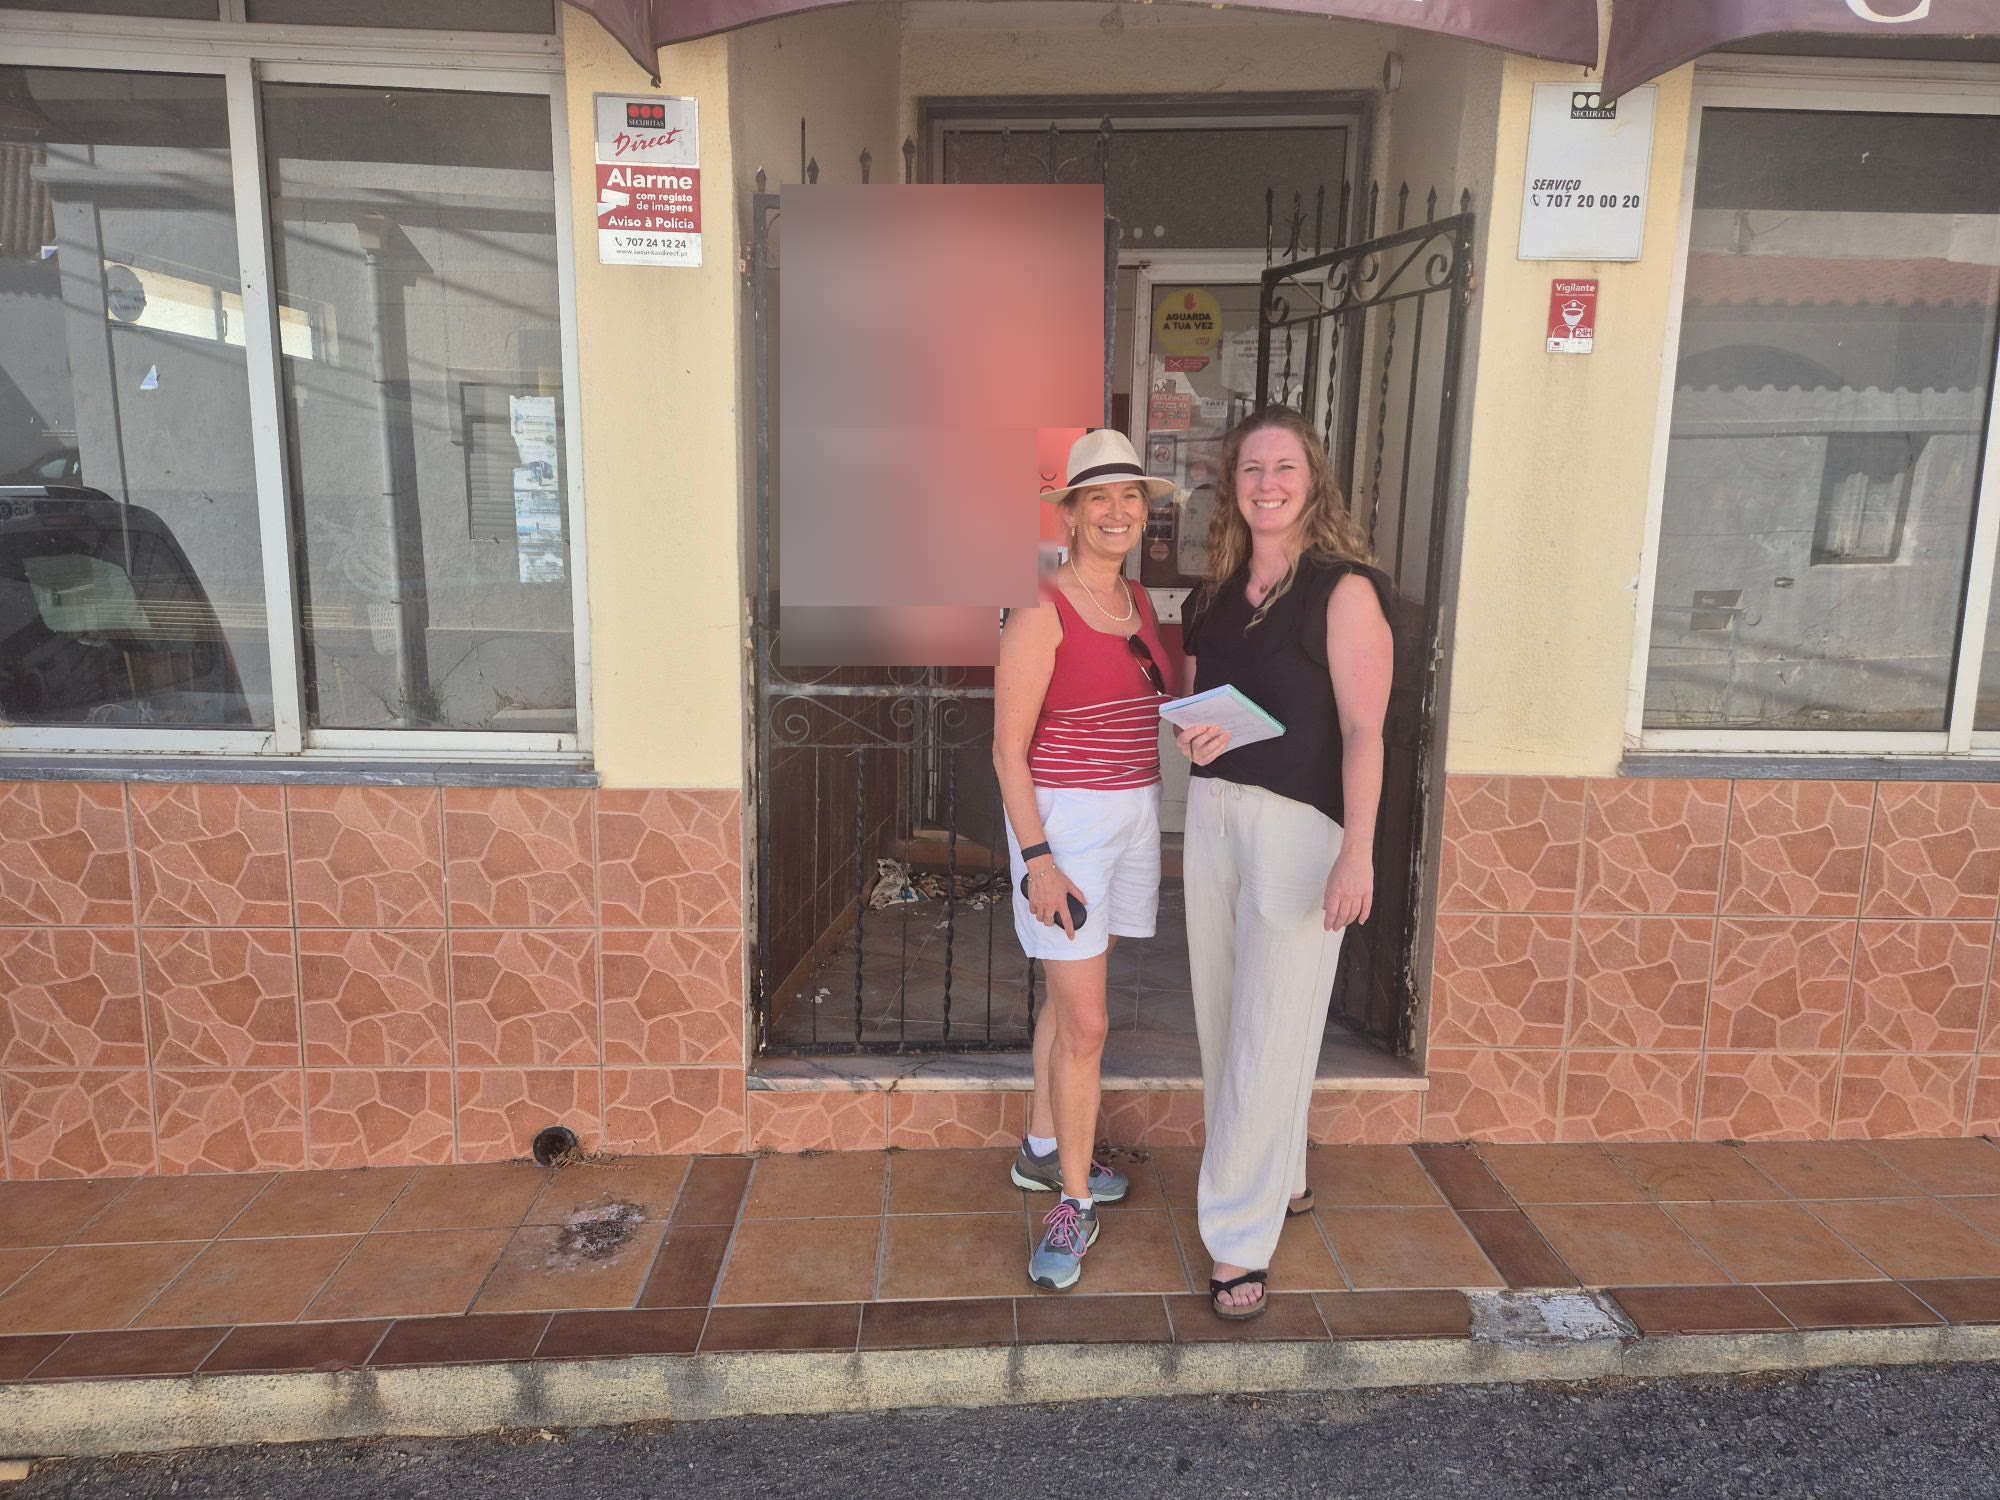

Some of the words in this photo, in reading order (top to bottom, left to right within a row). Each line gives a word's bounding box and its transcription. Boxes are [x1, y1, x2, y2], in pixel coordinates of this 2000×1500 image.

[628, 119, 665, 127] SECURITAS
[613, 127, 684, 157] Direct
[606, 167, 693, 190] Alarme
[1532, 178, 1581, 193] SERVIÇO
[635, 193, 656, 201] com
[658, 193, 693, 204] registo
[1546, 194, 1572, 207] 707
[1577, 194, 1595, 208] 20
[1599, 194, 1617, 208] 00
[1622, 194, 1640, 208] 20
[636, 201, 649, 210] de
[652, 201, 693, 213] imagens
[608, 215, 642, 227] Aviso
[644, 216, 652, 228] à
[655, 217, 694, 229] Polícia
[626, 237, 644, 247] 707
[646, 238, 658, 247] 24
[662, 239, 672, 248] 12
[674, 239, 687, 249] 24
[1556, 283, 1595, 293] Vigilante
[1166, 313, 1211, 321] AGUARDA
[1163, 322, 1170, 330] A
[1173, 322, 1191, 330] TUA
[1194, 322, 1214, 330] VEZ
[1577, 329, 1592, 337] 24H
